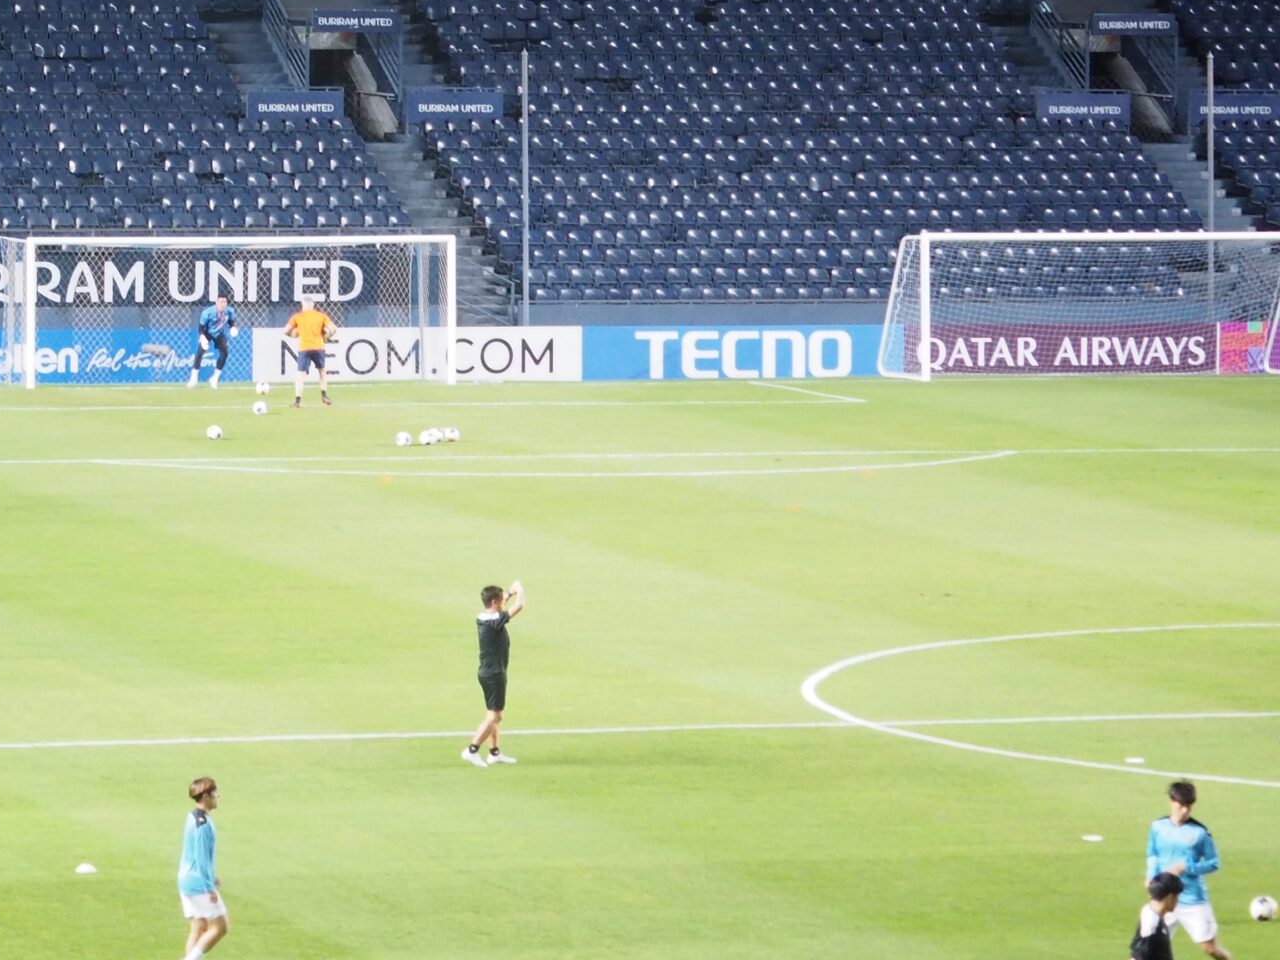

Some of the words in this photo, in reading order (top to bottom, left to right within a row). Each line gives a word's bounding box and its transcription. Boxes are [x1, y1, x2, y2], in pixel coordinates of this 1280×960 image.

[317, 16, 359, 27] BURIRAM
[360, 16, 393, 27] UNITED
[1098, 20, 1138, 30] BURIRAM
[1138, 20, 1171, 30] UNITED
[258, 103, 300, 113] BURIRAM
[300, 103, 335, 113] UNITED
[418, 103, 460, 113] BURIRAM
[460, 103, 494, 113] UNITED
[1048, 105, 1089, 115] BURIRAM
[1089, 105, 1122, 115] UNITED
[1199, 105, 1239, 115] BRIRAM
[1240, 105, 1272, 115] UNITED
[168, 259, 364, 304] UNITED
[634, 330, 852, 379] TECNO
[917, 336, 1039, 371] QATAR
[1053, 336, 1205, 367] AIRWAYS
